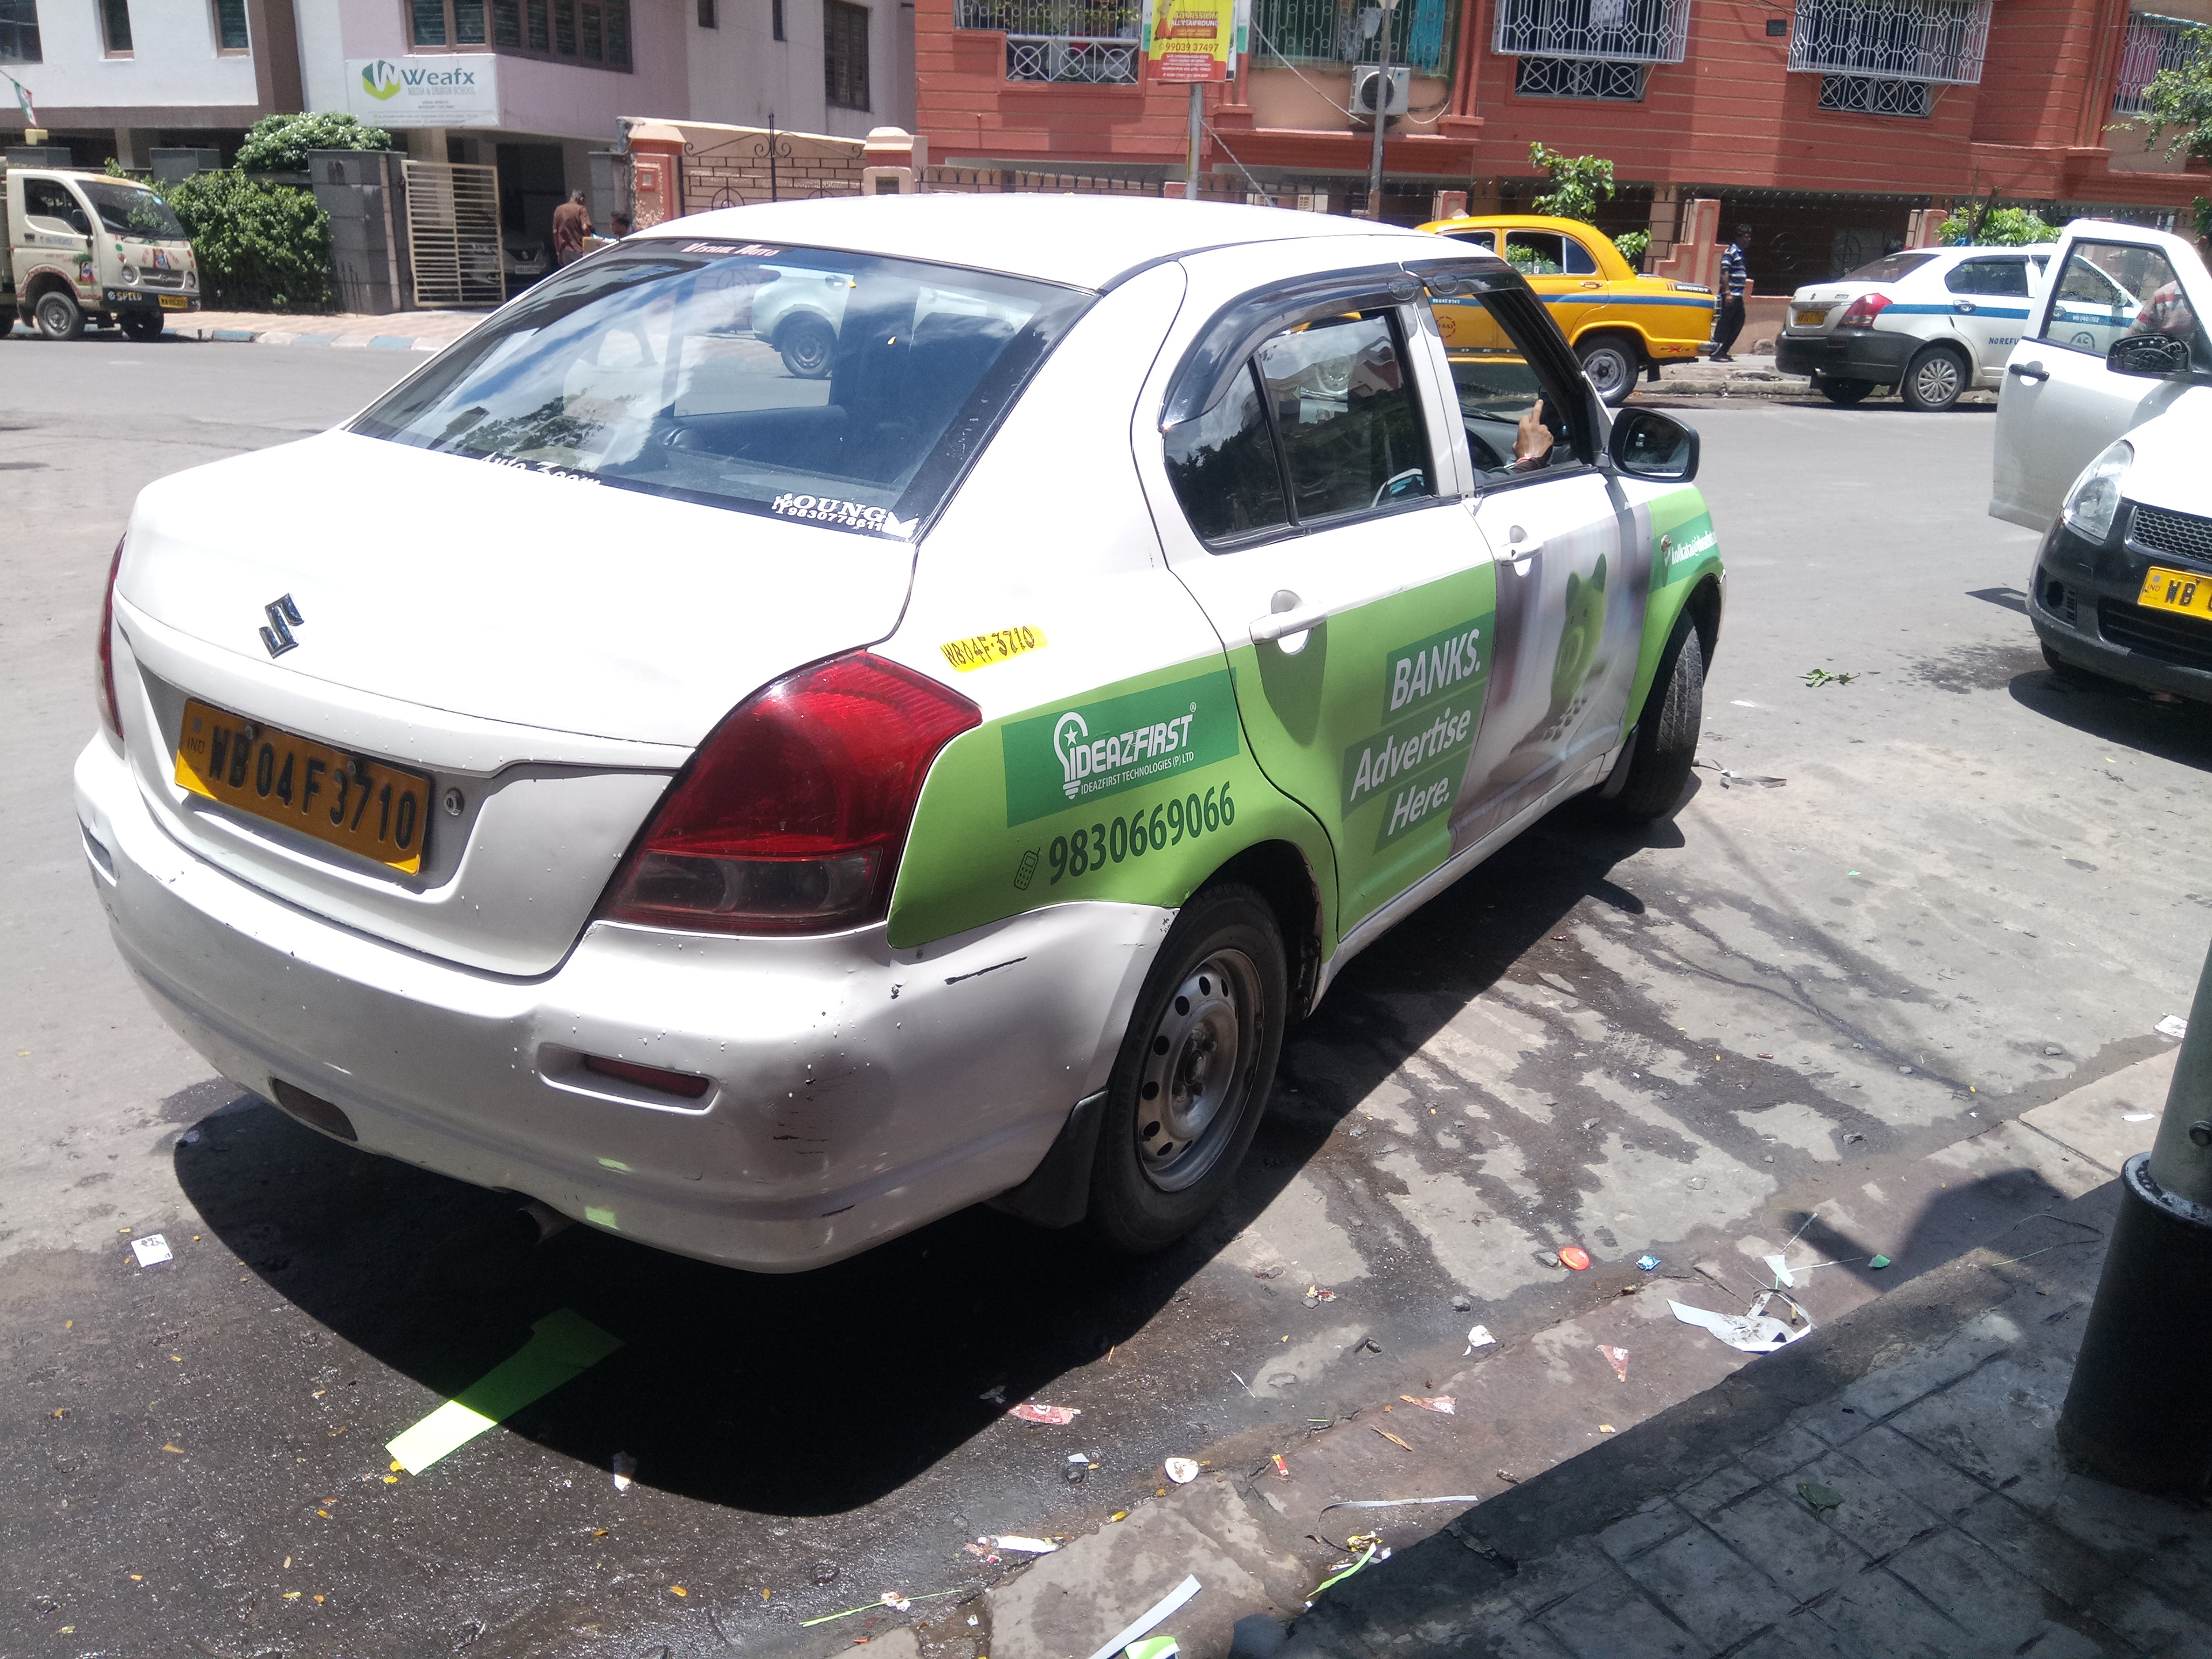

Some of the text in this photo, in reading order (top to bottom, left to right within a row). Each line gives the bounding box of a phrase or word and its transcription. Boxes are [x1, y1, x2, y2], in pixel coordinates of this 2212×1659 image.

[1173, 11, 1218, 20] ADMISSION
[1165, 42, 1219, 52] 99039 37497
[401, 67, 475, 85] Weafx
[408, 86, 475, 96] MEDIA & DESIGN SCHOOL
[2147, 584, 2161, 592] IND
[2164, 579, 2196, 607] WB
[1390, 628, 1481, 711] BANKS.
[1350, 707, 1471, 802] Advertise
[1081, 751, 1194, 795] IDEAZFIRST TECHNOLOGIES (P) LTD
[1387, 778, 1450, 836] Here.
[1049, 781, 1236, 885] 9830669066
